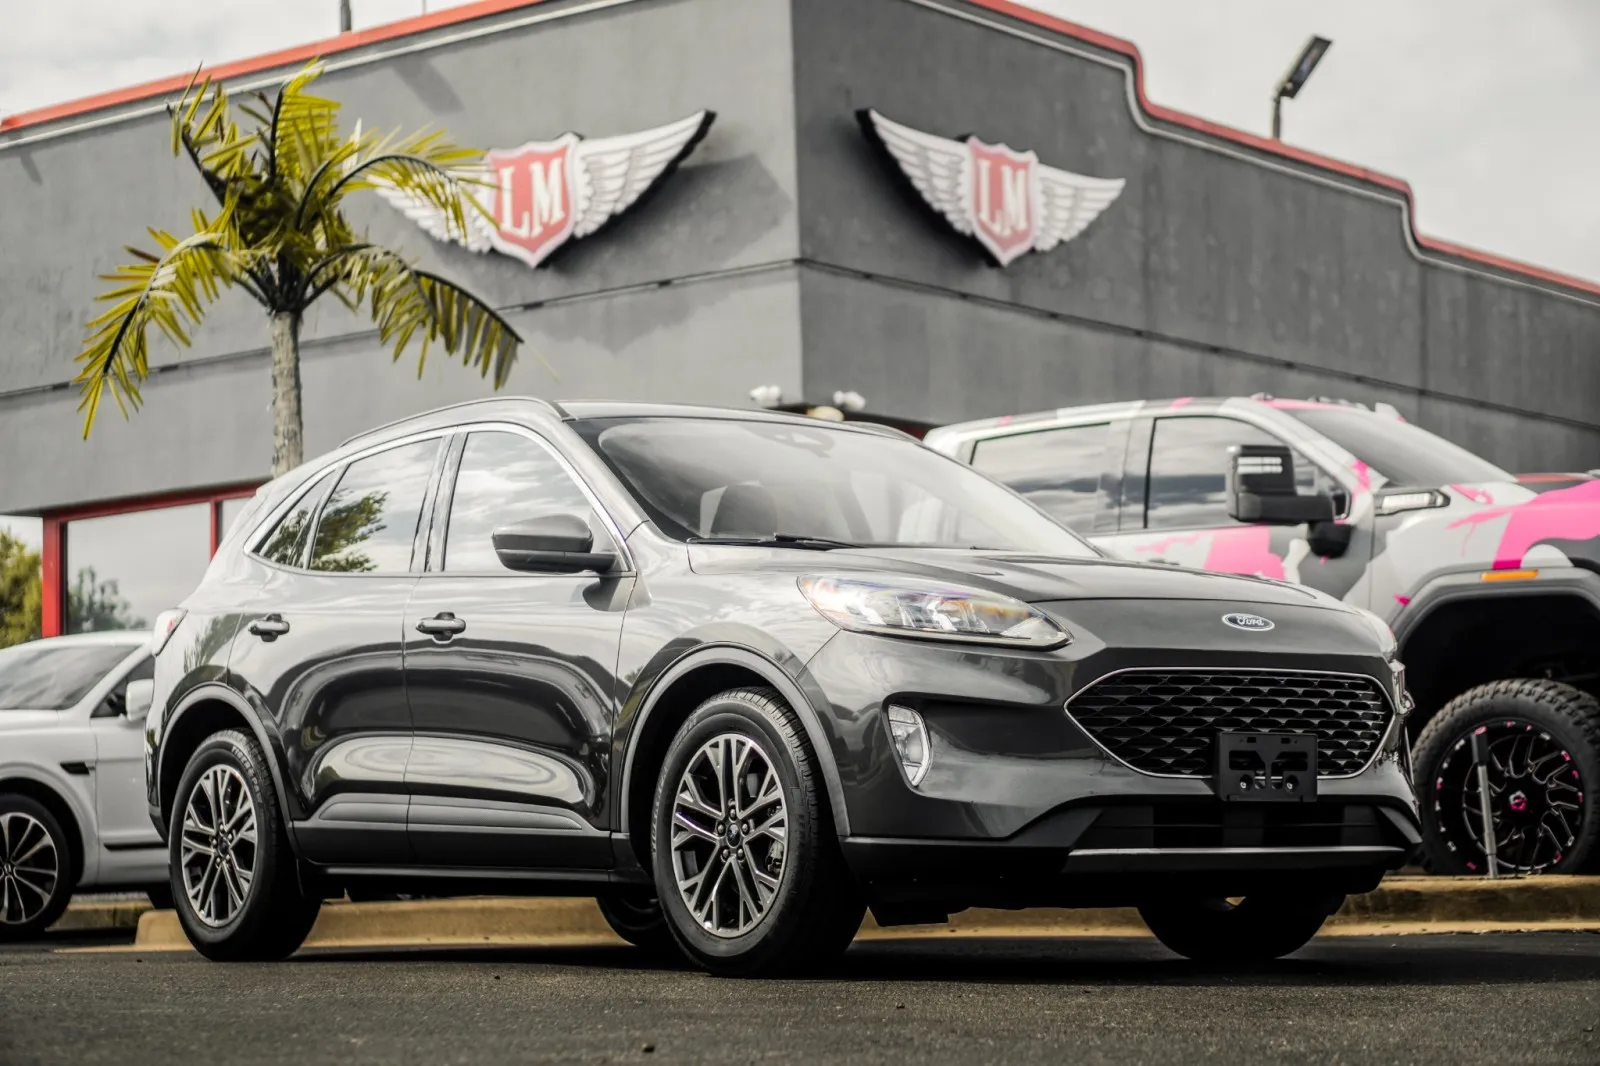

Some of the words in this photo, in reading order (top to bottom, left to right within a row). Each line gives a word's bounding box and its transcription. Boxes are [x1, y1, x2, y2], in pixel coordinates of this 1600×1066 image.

[500, 157, 566, 238] LM
[977, 158, 1030, 237] LM
[1236, 615, 1265, 626] Ford
